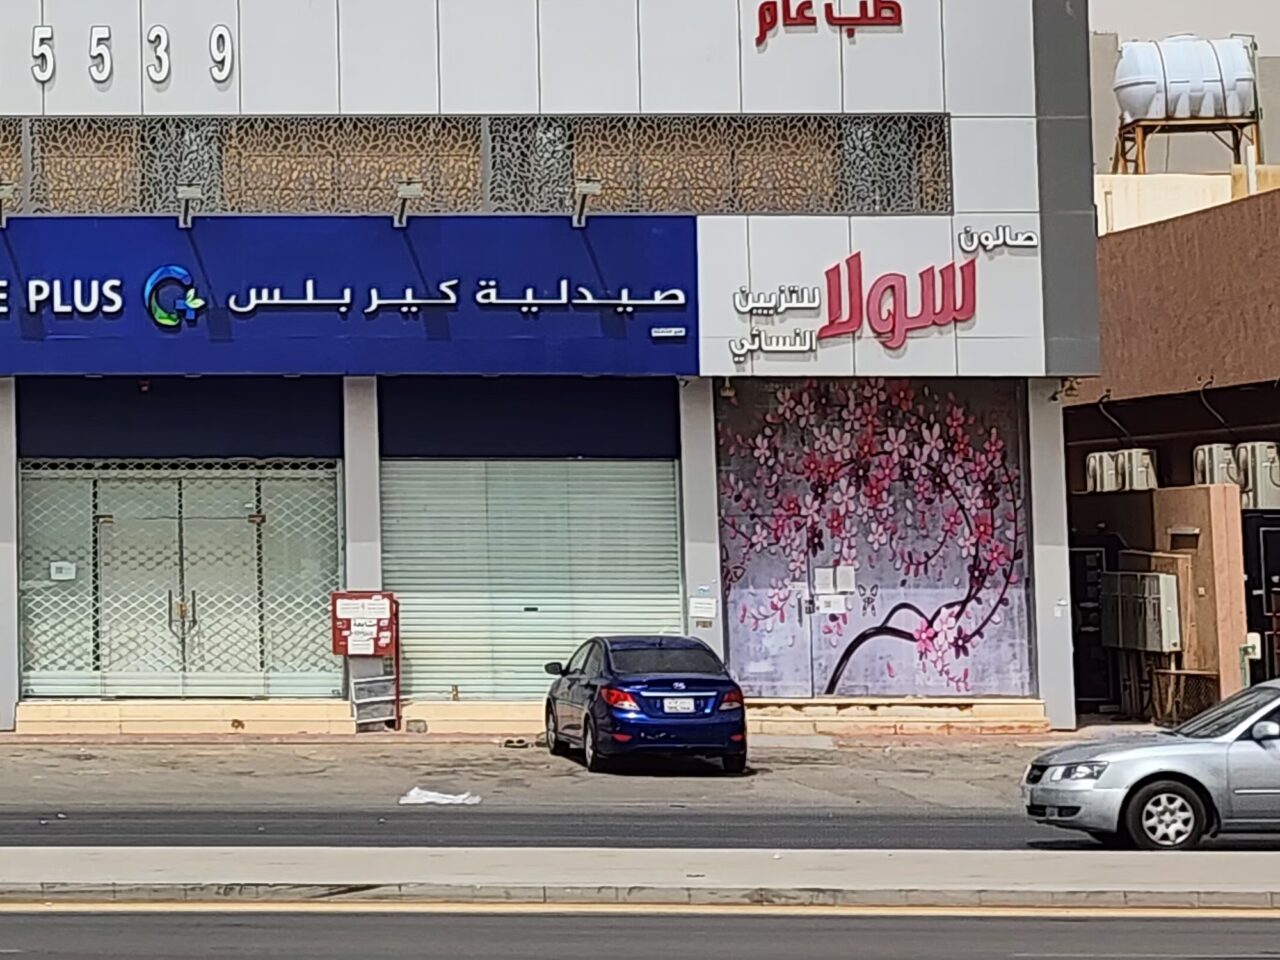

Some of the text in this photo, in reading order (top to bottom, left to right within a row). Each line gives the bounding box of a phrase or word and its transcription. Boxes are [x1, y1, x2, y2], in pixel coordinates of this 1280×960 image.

[958, 224, 1039, 253] صالون
[27, 279, 123, 313] PLUS
[228, 278, 687, 313] صيدلية كير بلس
[732, 285, 821, 315] للتزيين
[816, 250, 977, 350] سولا
[728, 328, 818, 363] النسائي
